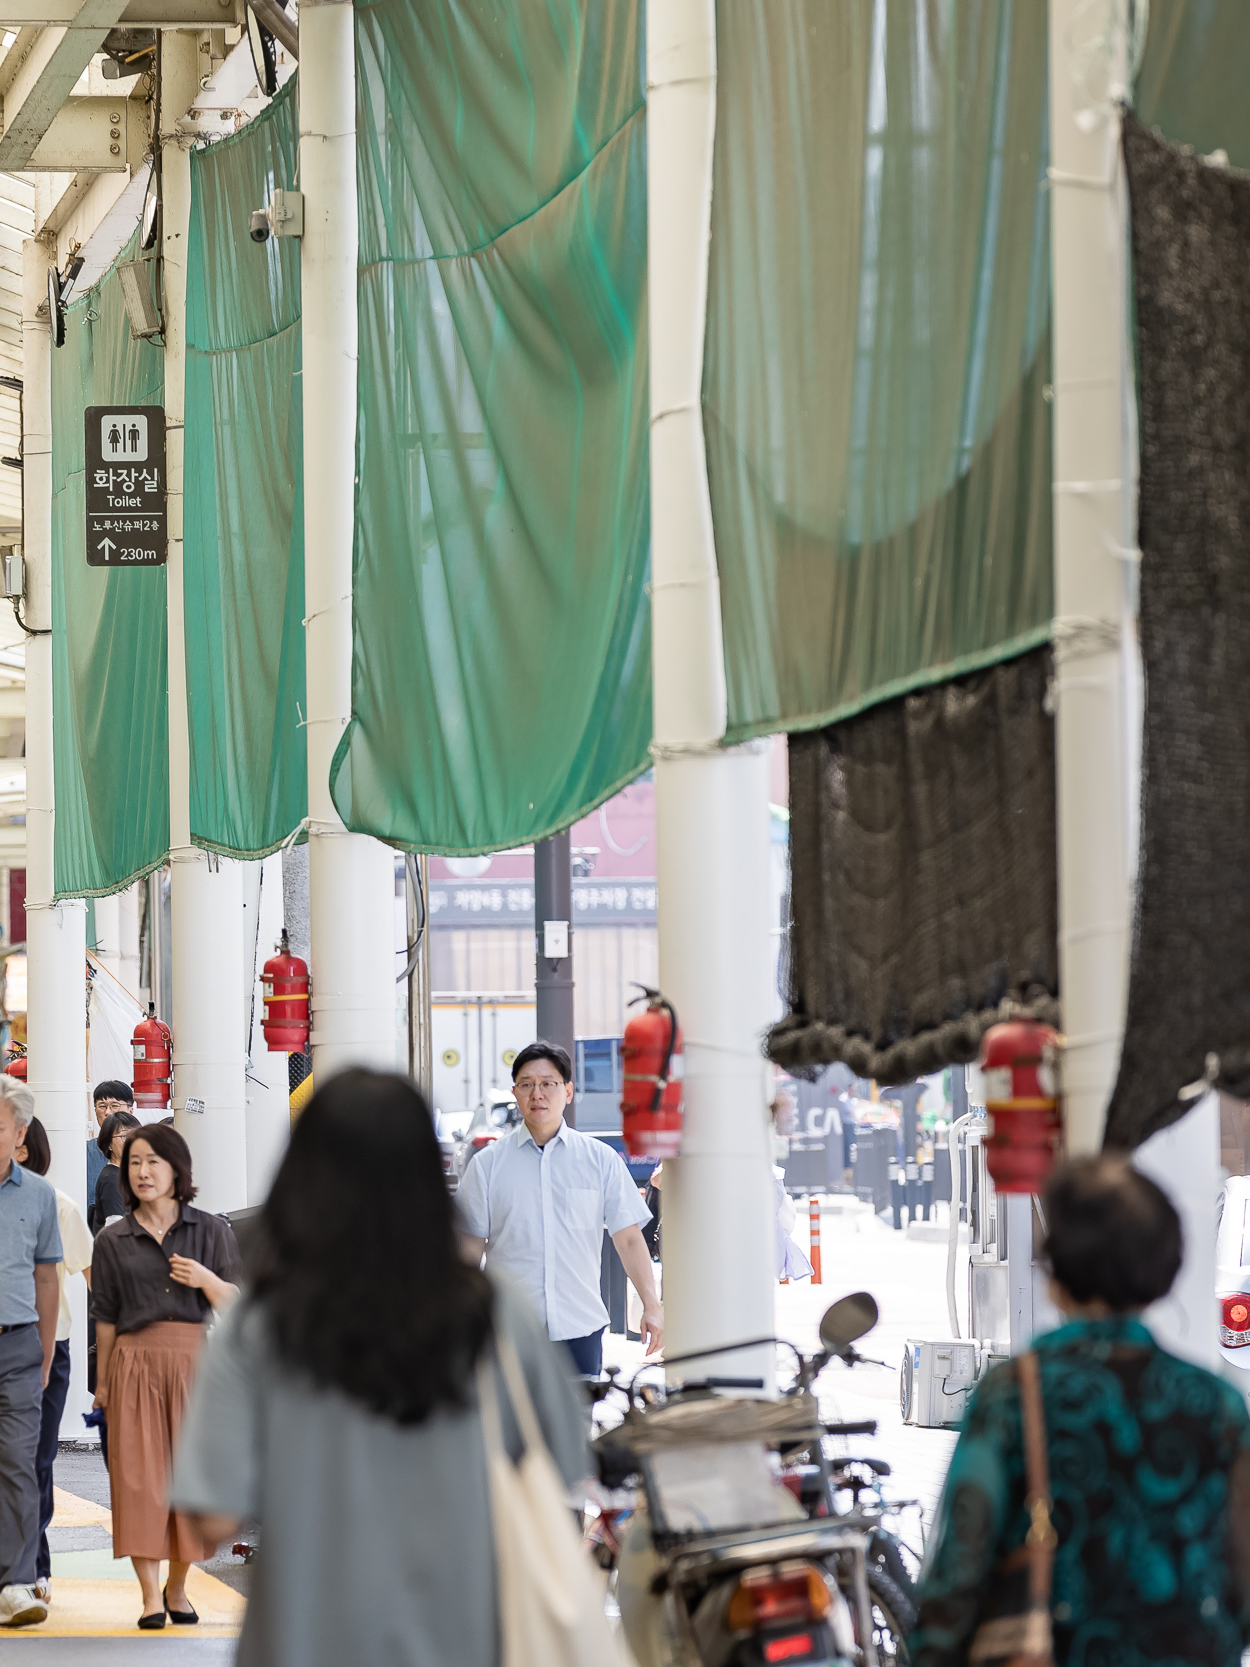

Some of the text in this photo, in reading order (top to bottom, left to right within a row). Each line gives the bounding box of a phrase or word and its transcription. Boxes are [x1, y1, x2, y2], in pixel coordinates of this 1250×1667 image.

[93, 468, 159, 493] 화장실
[106, 495, 142, 508] Toilet
[92, 519, 160, 532] 노루산슈퍼2층
[120, 547, 157, 560] 230m
